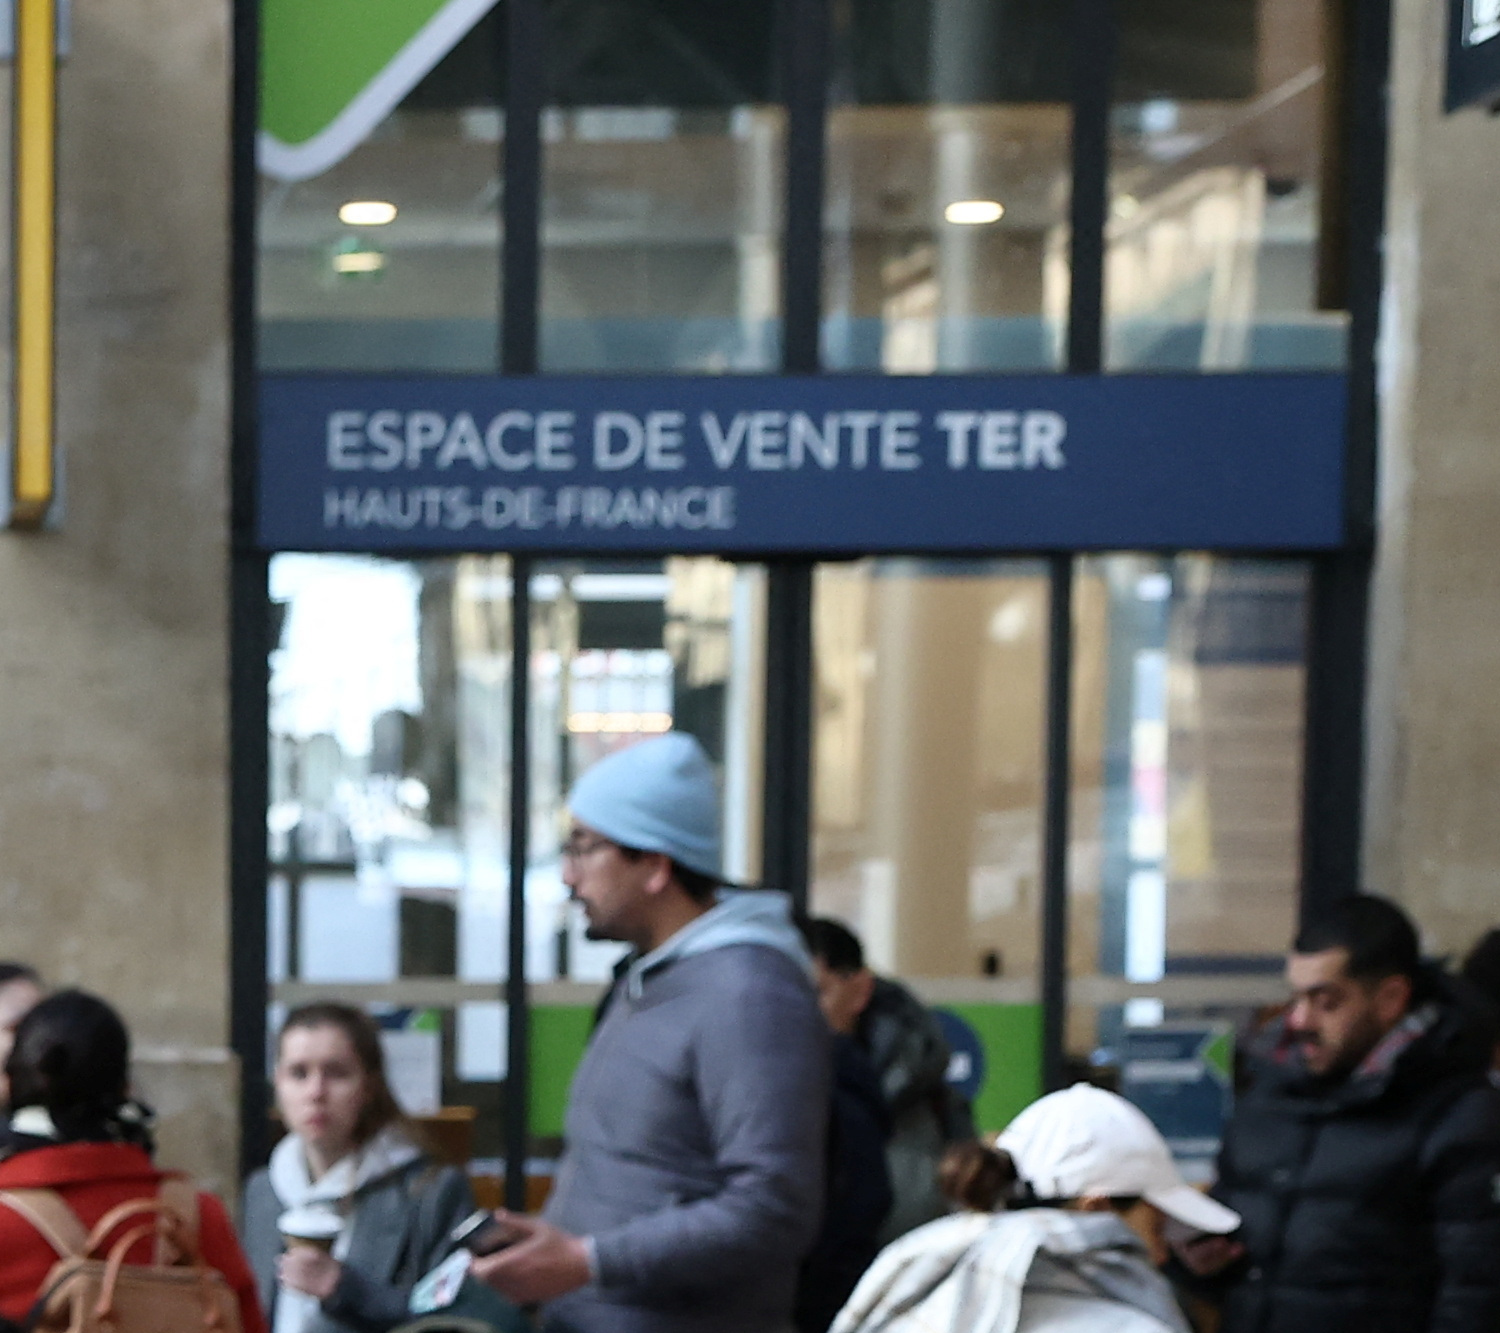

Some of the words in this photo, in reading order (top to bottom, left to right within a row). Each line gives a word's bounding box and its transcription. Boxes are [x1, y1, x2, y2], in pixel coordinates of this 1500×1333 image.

[327, 409, 576, 472] ESPACE
[592, 409, 685, 471] DE
[700, 409, 921, 471] VENTE
[935, 409, 1067, 470] TER
[323, 484, 736, 531] HAUTS-DE-FRANCE
